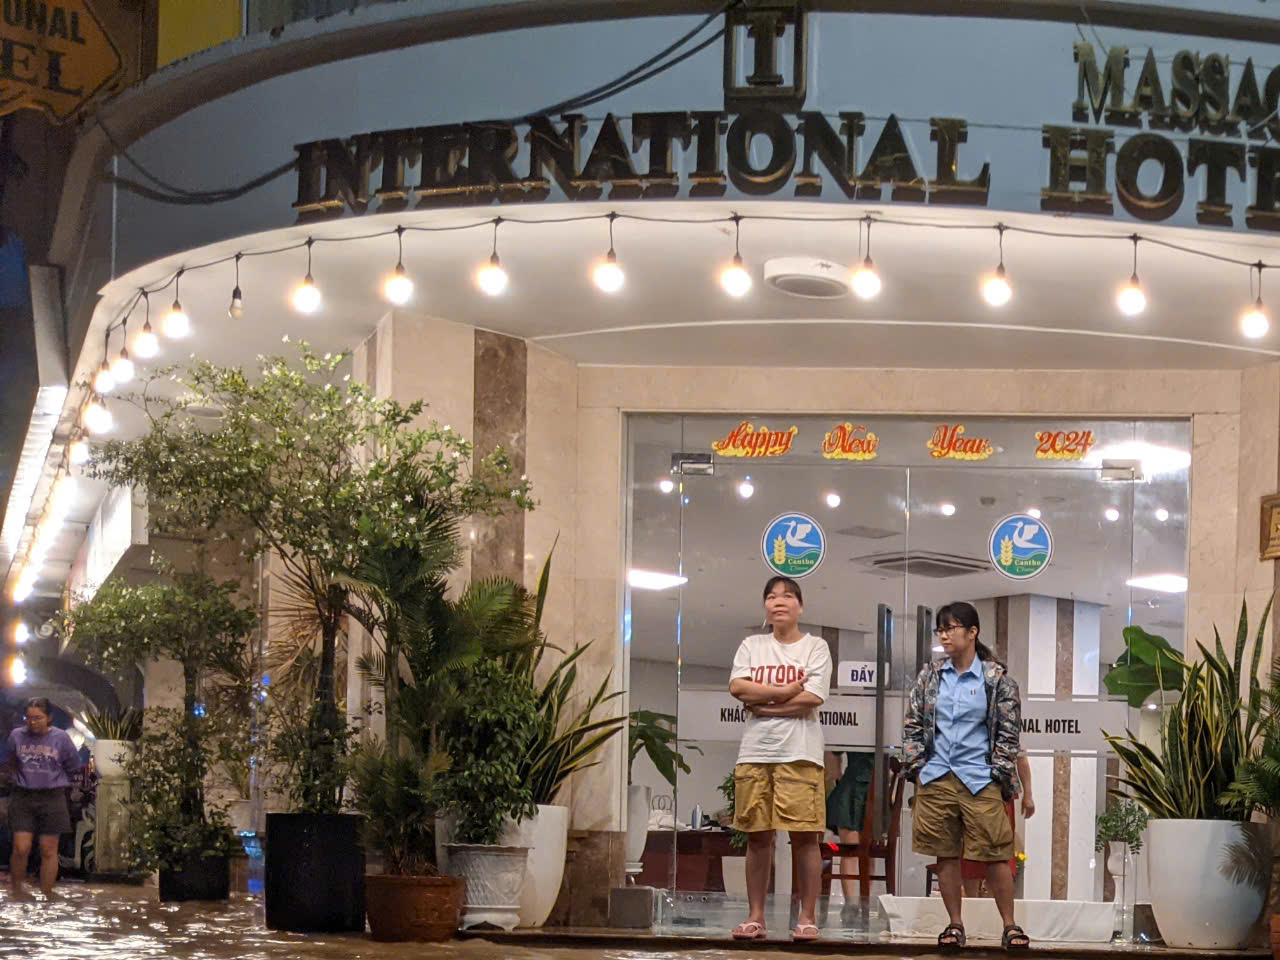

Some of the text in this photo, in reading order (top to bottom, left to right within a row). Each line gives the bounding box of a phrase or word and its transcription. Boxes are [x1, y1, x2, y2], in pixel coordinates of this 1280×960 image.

[294, 110, 990, 224] INTERNATIONAL
[712, 421, 1095, 459] Happy New Year 2024
[1045, 718, 1081, 734] HOTEL
